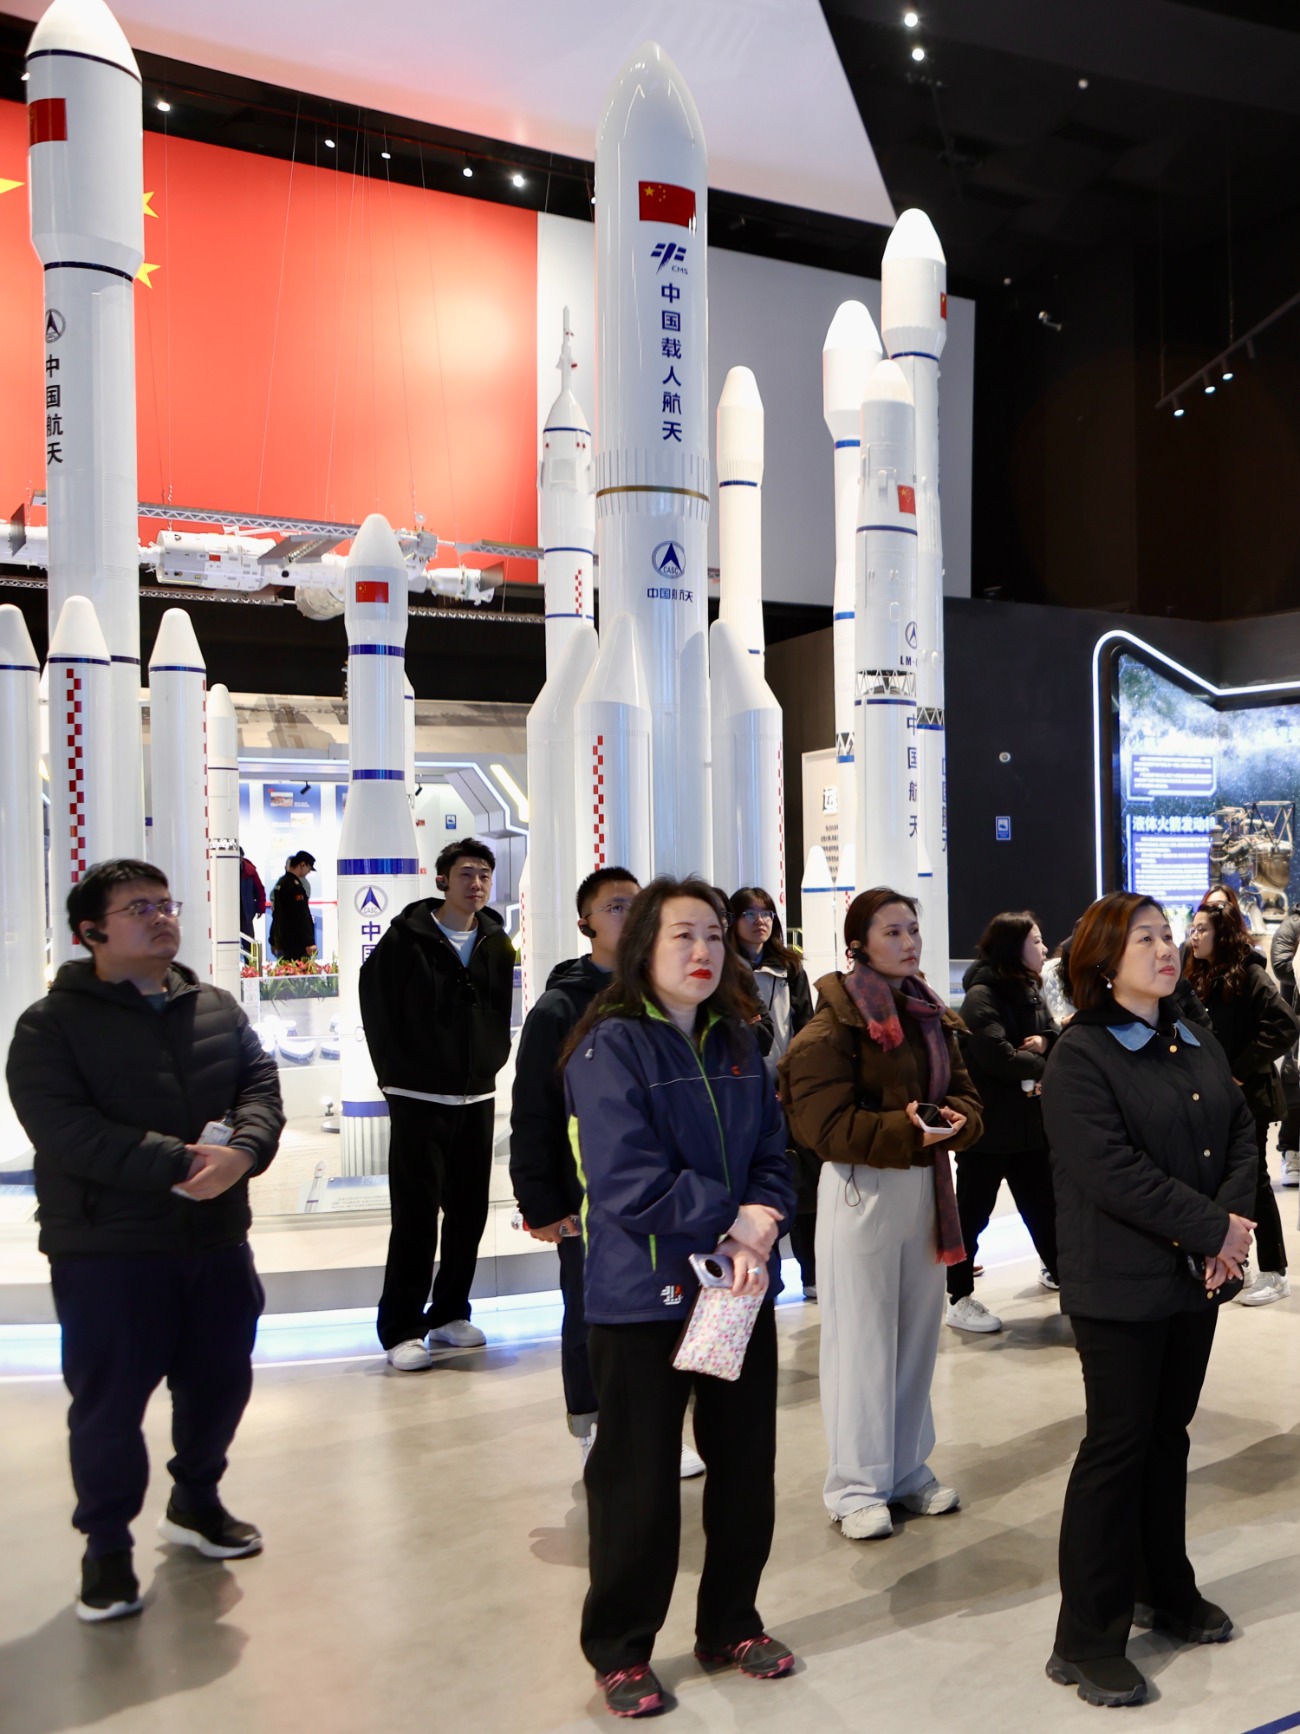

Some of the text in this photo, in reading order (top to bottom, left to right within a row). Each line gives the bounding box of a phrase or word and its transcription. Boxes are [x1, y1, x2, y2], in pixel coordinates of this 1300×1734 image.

[671, 265, 689, 275] CMS
[661, 282, 682, 443] 中国载人航天
[45, 354, 63, 466] 中国航天
[663, 566, 679, 574] CASC
[900, 655, 918, 667] LM-
